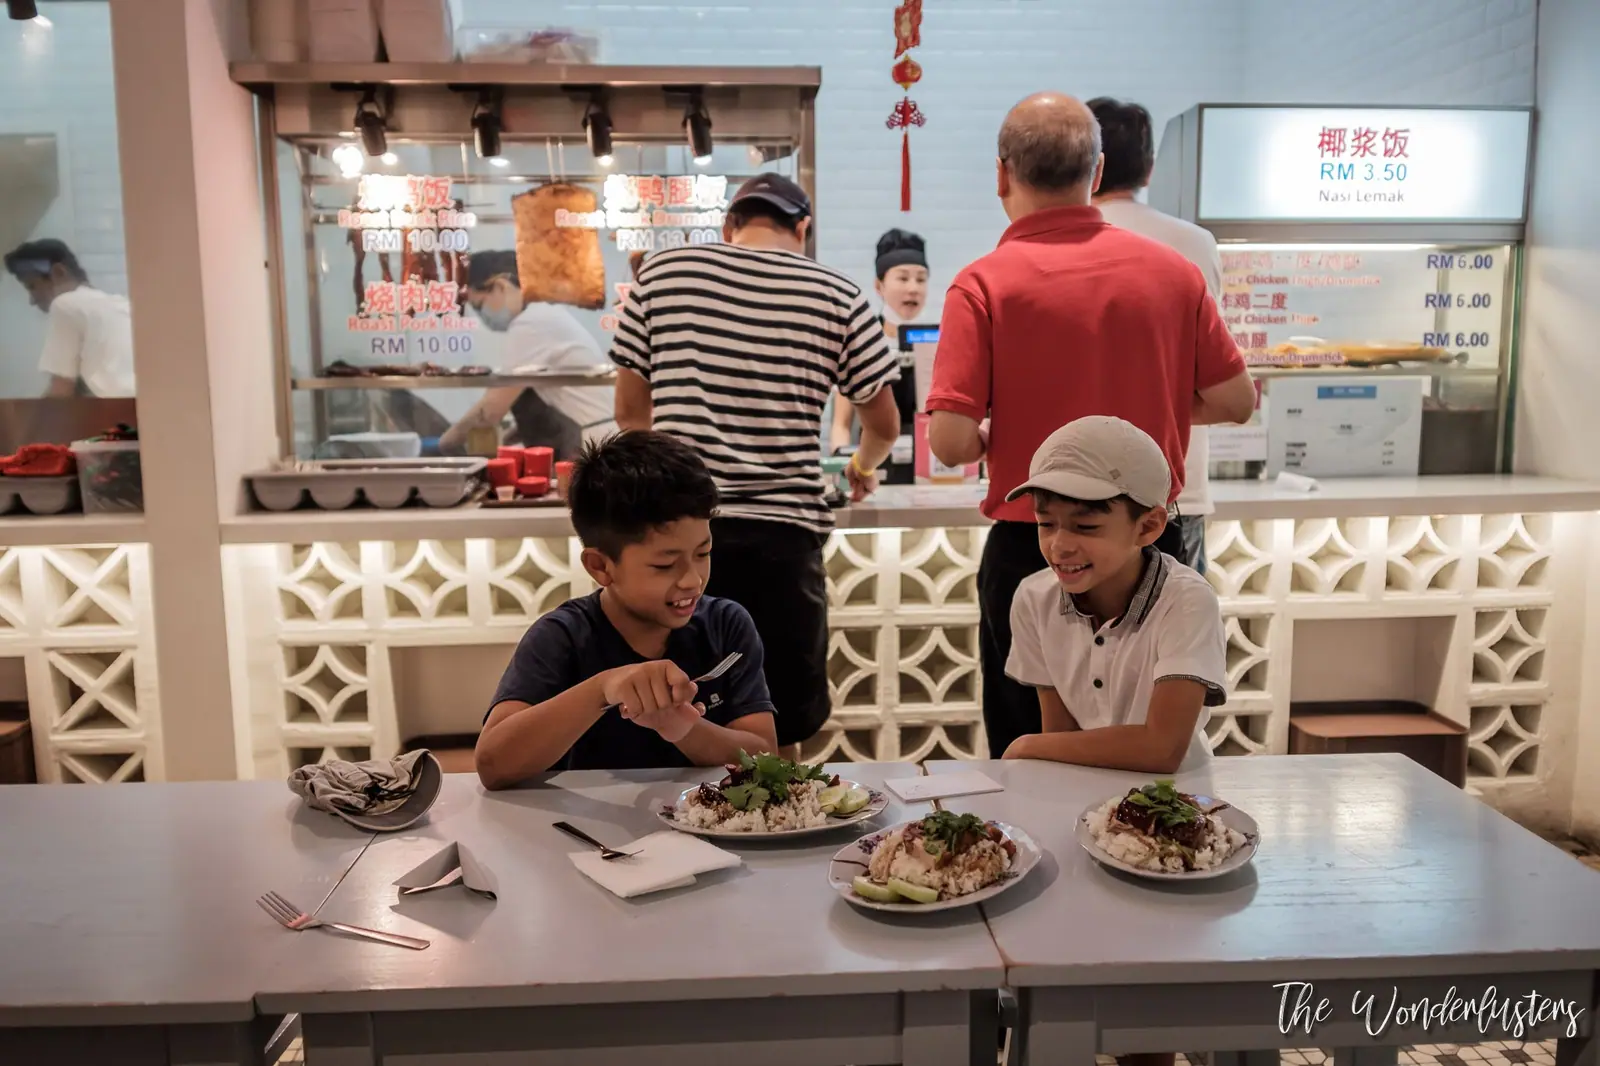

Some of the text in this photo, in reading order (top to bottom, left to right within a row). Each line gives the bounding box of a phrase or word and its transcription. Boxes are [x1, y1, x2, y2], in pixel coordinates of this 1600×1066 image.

[1317, 126, 1411, 158] 椰浆饭
[1320, 163, 1408, 181] RM 3.50
[1319, 189, 1405, 203] Nasi Lemak
[364, 232, 466, 250] RM 10.00
[620, 231, 653, 249] RM
[1427, 254, 1493, 269] RM 6.00
[366, 282, 458, 312] 烧肉饭
[1424, 293, 1491, 308] RM 6.00
[348, 315, 478, 331] Roast Pork Rice
[1245, 314, 1287, 324] Chicken
[371, 335, 472, 353] RM 10.00
[1423, 332, 1489, 347] RM 6.00
